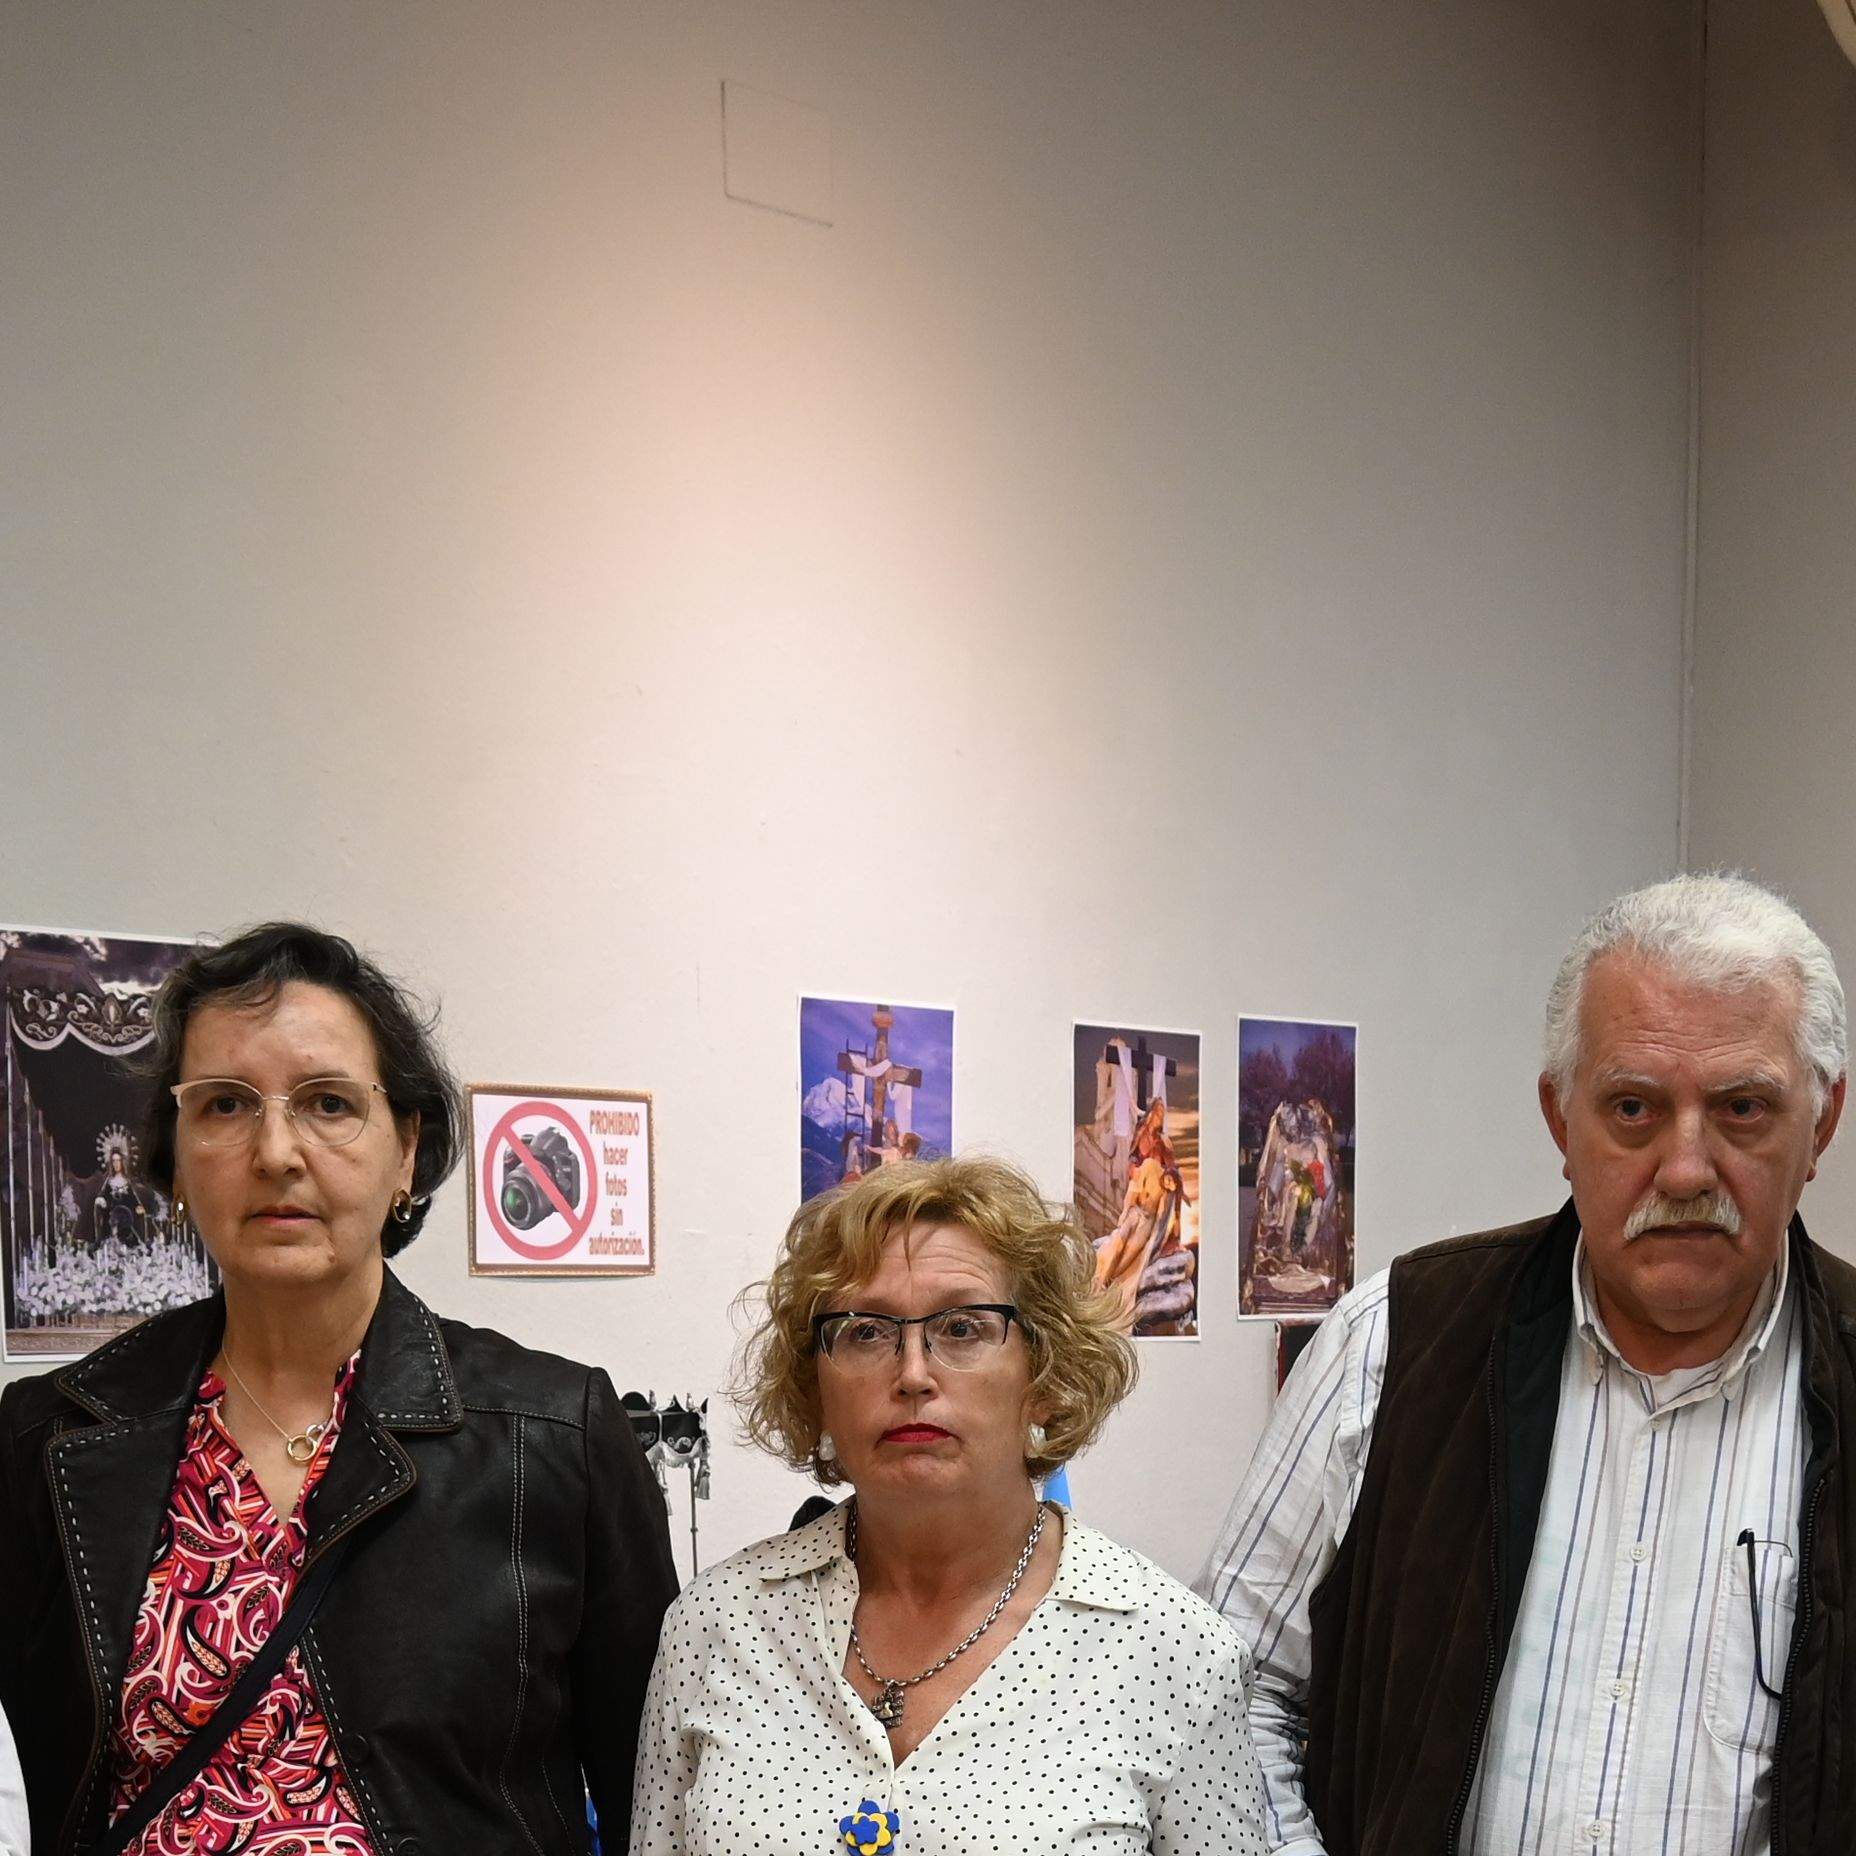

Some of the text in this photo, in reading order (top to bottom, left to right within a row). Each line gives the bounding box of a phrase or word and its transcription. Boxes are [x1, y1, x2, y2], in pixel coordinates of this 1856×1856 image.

[589, 1109, 640, 1136] PROHIBIDO
[603, 1141, 628, 1166] hacer
[605, 1171, 627, 1197] fotos
[610, 1202, 623, 1226] sin
[588, 1231, 645, 1256] autorización.
